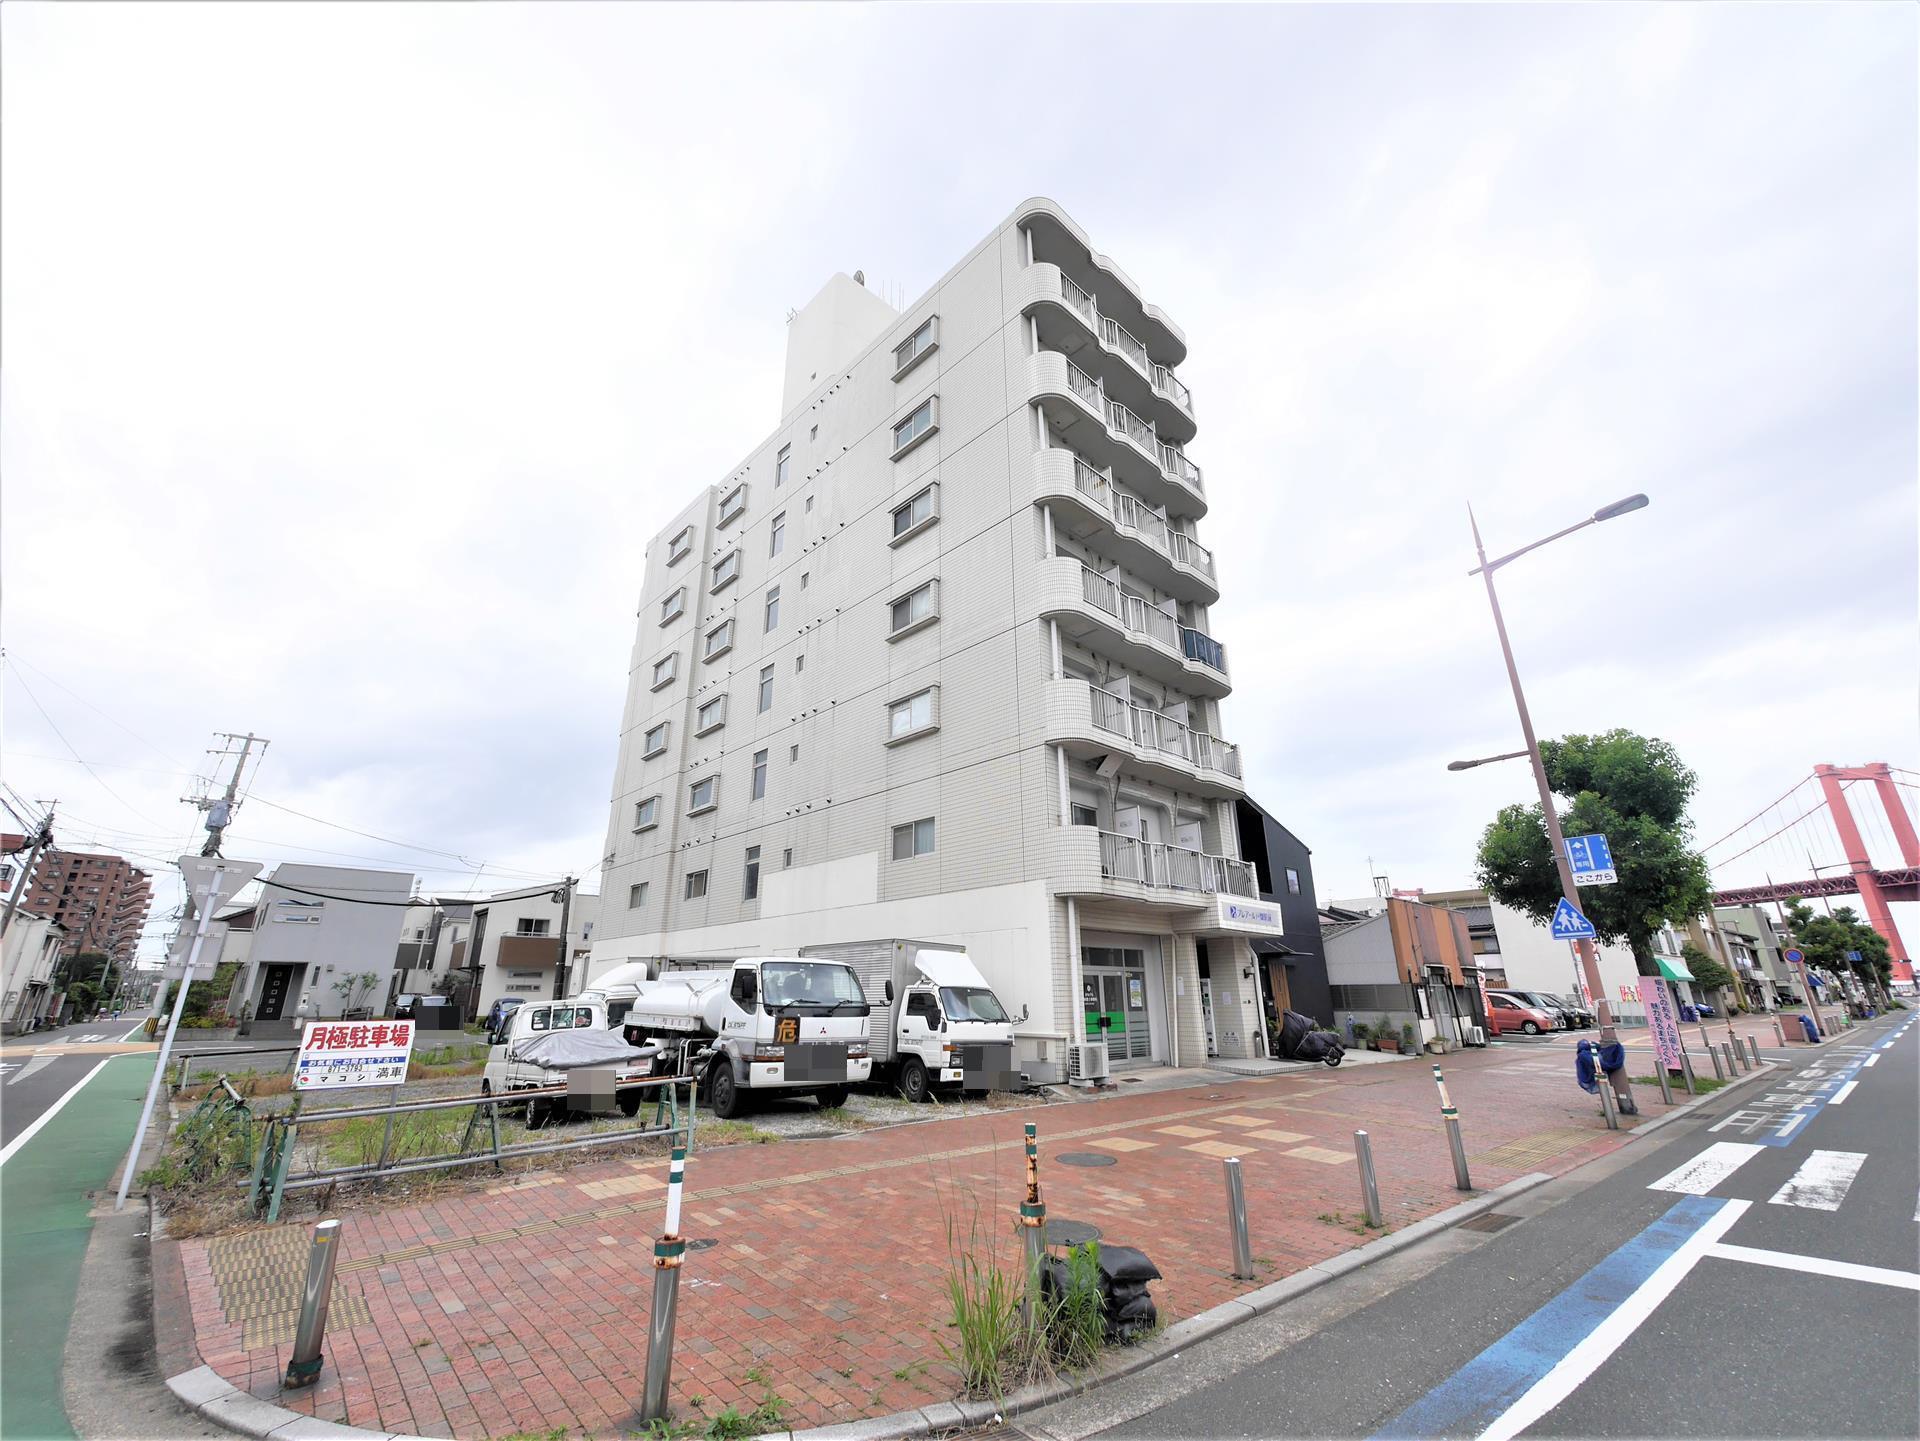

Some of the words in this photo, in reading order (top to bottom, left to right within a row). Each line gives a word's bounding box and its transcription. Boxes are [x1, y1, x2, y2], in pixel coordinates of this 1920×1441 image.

[1576, 873, 1613, 883] ここから
[777, 1019, 797, 1042] 危
[305, 1024, 409, 1050] 月極駐車場
[308, 1057, 399, 1066] お気軽にお問合せ下さい
[327, 1065, 363, 1073] 871-3793
[376, 1066, 403, 1079] 満車
